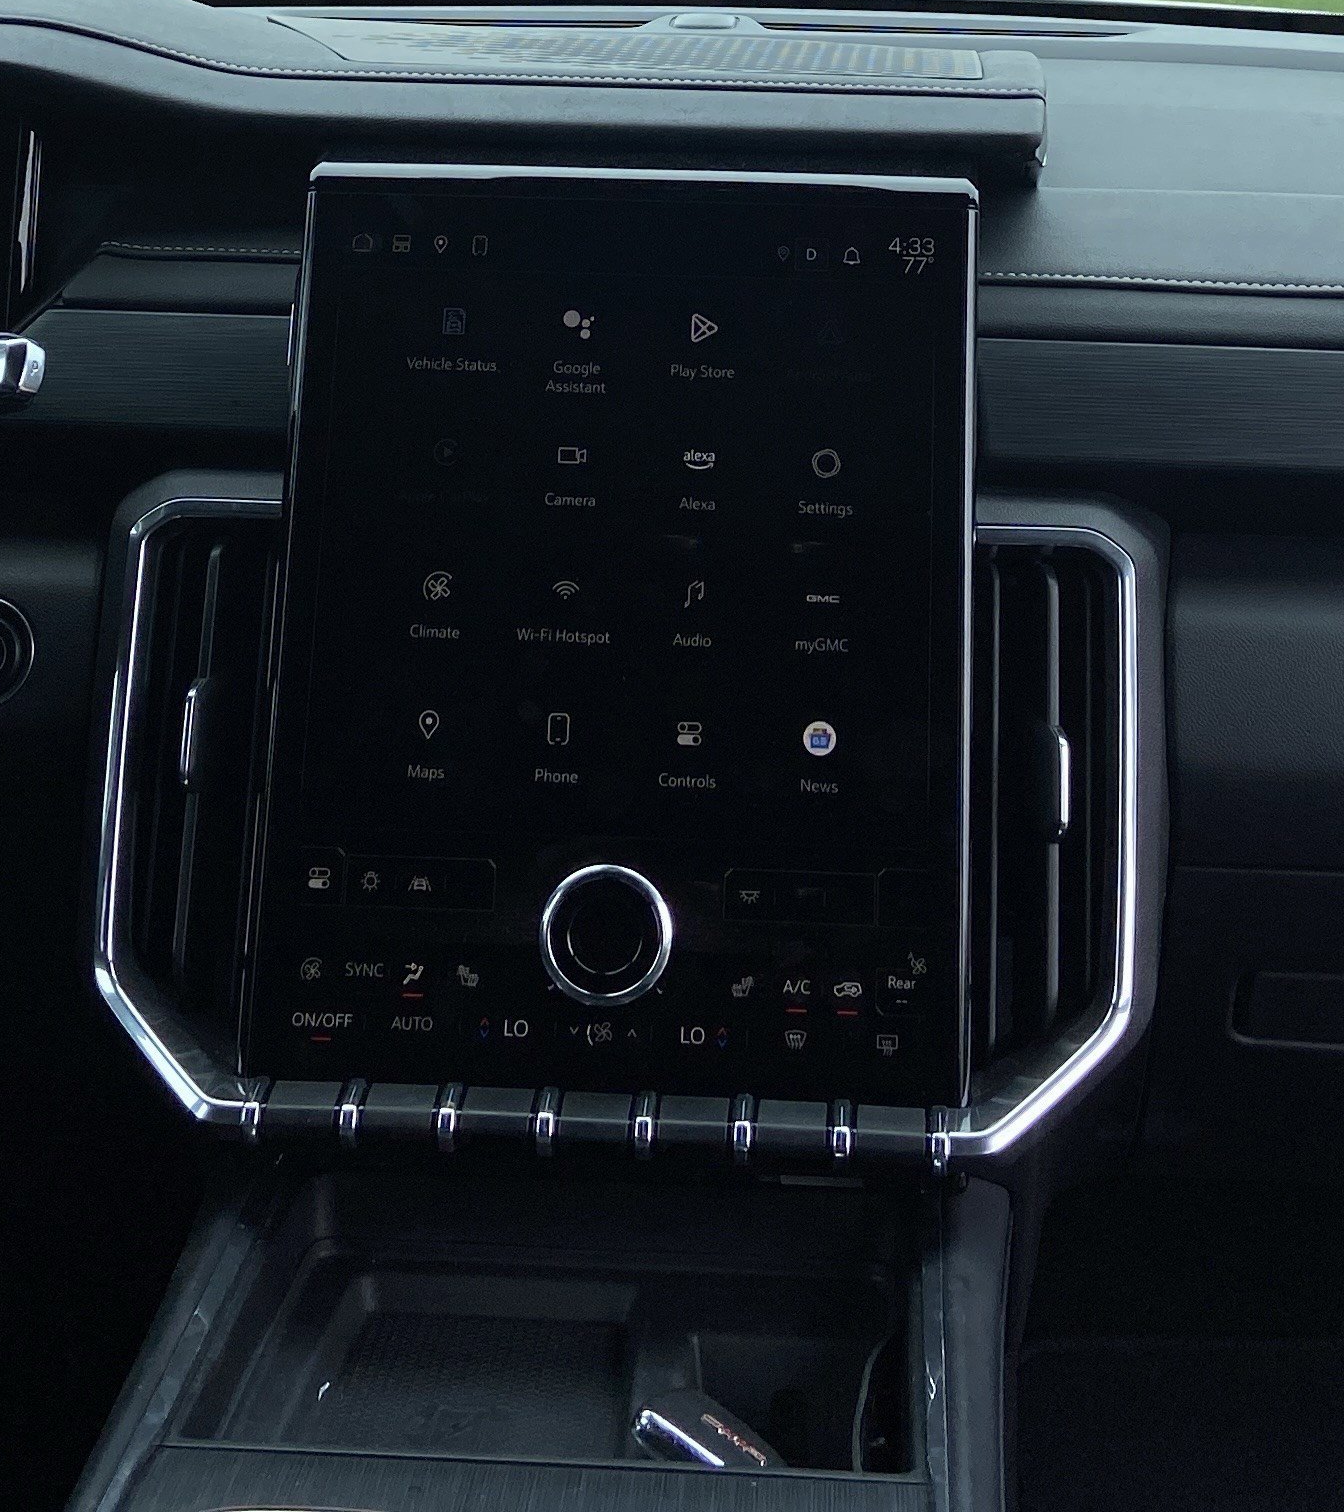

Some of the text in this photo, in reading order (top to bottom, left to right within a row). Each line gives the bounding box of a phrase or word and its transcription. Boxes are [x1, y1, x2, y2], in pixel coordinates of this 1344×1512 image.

[888, 237, 935, 255] 4:33
[902, 256, 935, 275] 77°
[406, 356, 497, 371] Vehicle Status
[553, 361, 601, 378] Google
[670, 364, 734, 381] Play Store
[545, 379, 607, 395] Assistant
[683, 450, 716, 462] alexa
[544, 493, 596, 508] Camera
[679, 497, 716, 511] Alexa
[798, 501, 853, 518] Settings
[806, 594, 840, 604] GMC
[409, 624, 460, 640] Climate
[516, 628, 611, 646] Wi-Fi Hotspot
[672, 633, 712, 648] Audio
[795, 638, 849, 654] myGMC
[407, 765, 445, 782] Maps
[534, 769, 579, 784] Phone
[658, 773, 716, 789] Controls
[800, 779, 839, 794] News
[345, 962, 384, 978] SYNC
[783, 978, 811, 995] A/C
[887, 977, 916, 990] Rear
[291, 1012, 353, 1029] ON/OFF
[391, 1016, 433, 1032] AUTO
[503, 1020, 529, 1038] LO
[680, 1027, 705, 1045] LO
